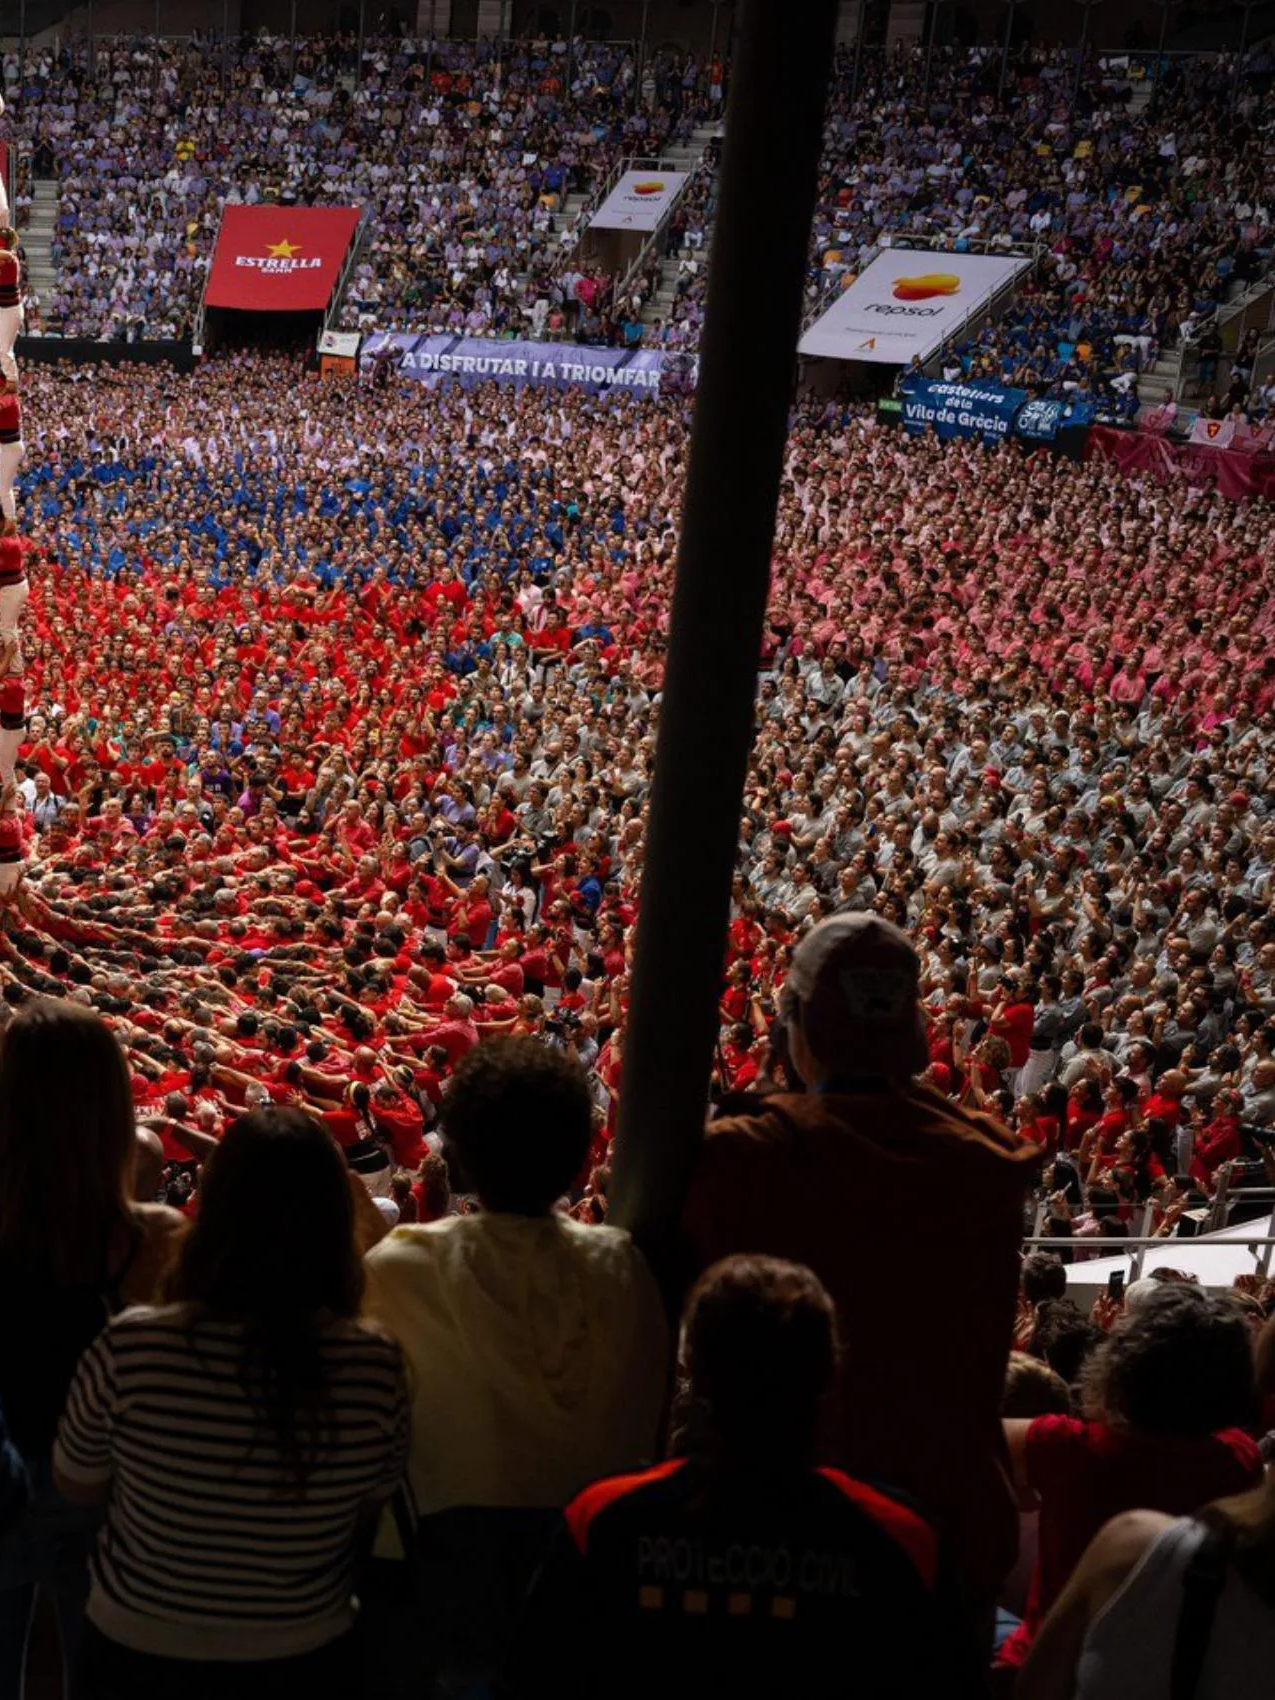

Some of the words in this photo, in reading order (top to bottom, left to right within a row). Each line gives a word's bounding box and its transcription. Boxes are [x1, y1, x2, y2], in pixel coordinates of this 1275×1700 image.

[235, 256, 321, 269] ESTRELLA
[863, 303, 945, 317] repsol
[401, 351, 417, 368] A
[420, 354, 527, 376] DISFRUTAR
[541, 361, 556, 379] A
[561, 363, 660, 388] TRIOMFAR
[905, 404, 937, 422] Vila
[936, 408, 956, 424] de
[958, 411, 1008, 432] Gràcia
